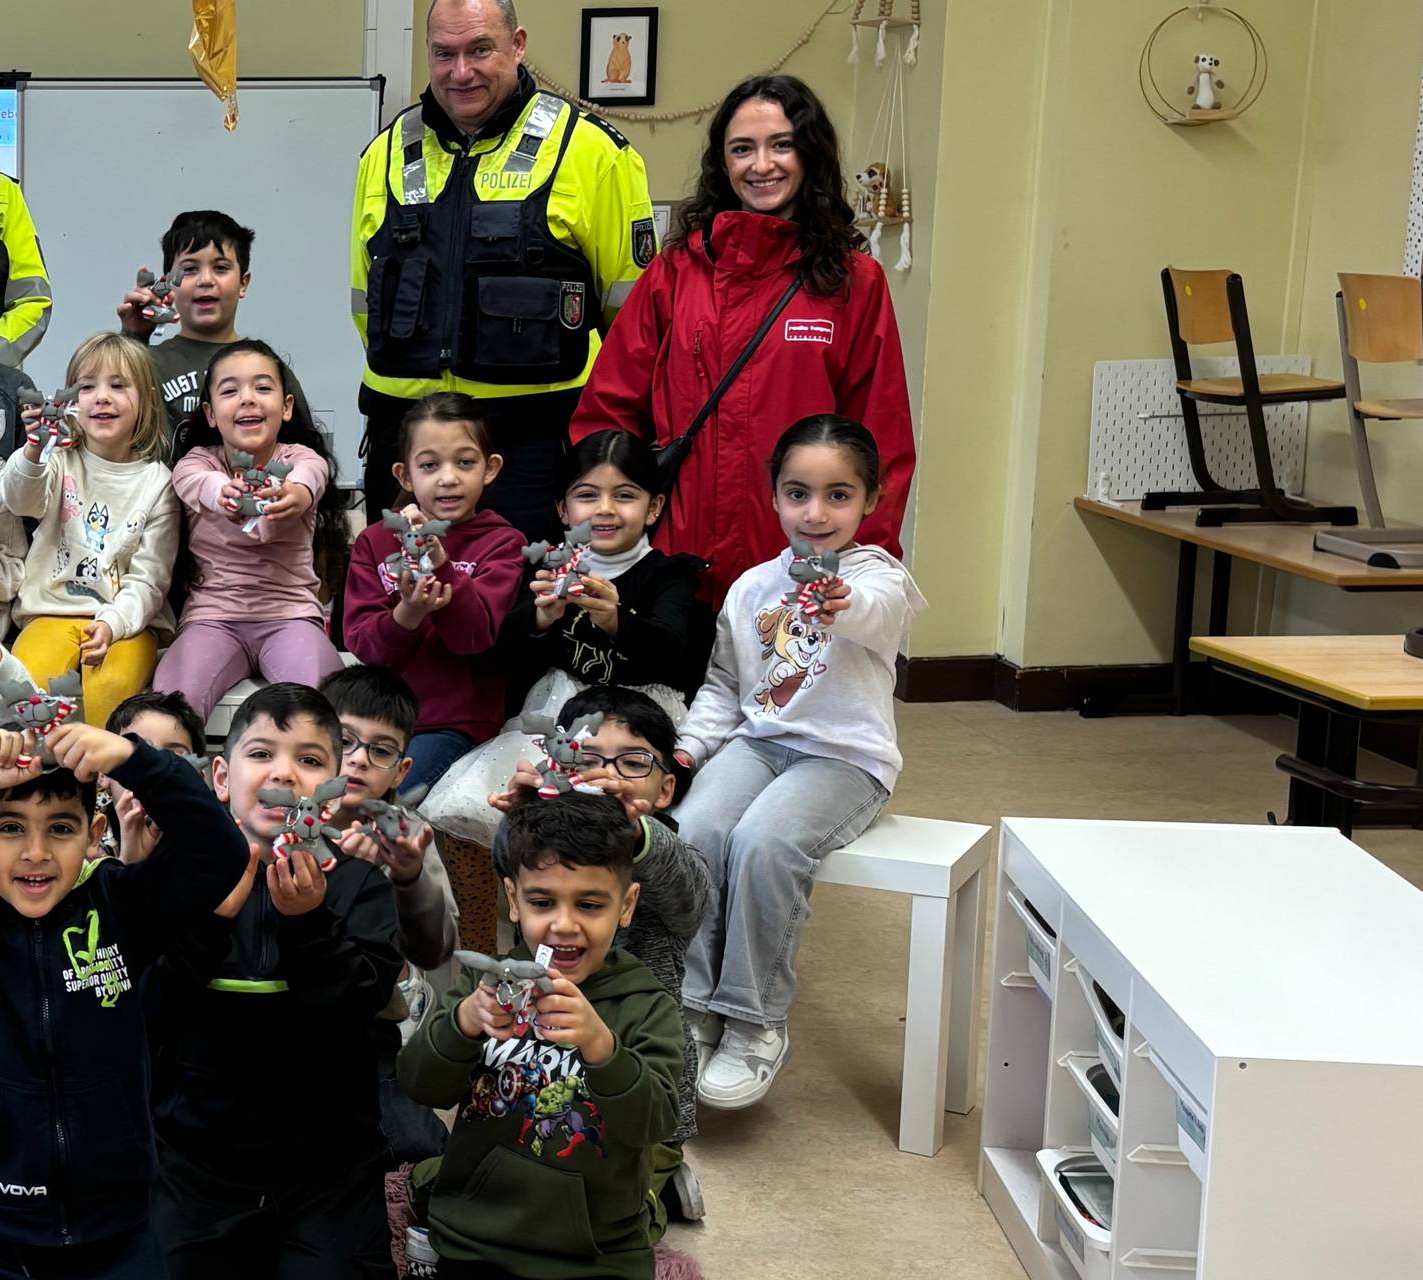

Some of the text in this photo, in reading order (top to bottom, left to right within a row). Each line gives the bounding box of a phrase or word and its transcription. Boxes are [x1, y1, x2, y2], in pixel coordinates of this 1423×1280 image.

[481, 172, 532, 189] POLIZEI
[162, 371, 197, 402] JUST
[95, 985, 106, 997] BY
